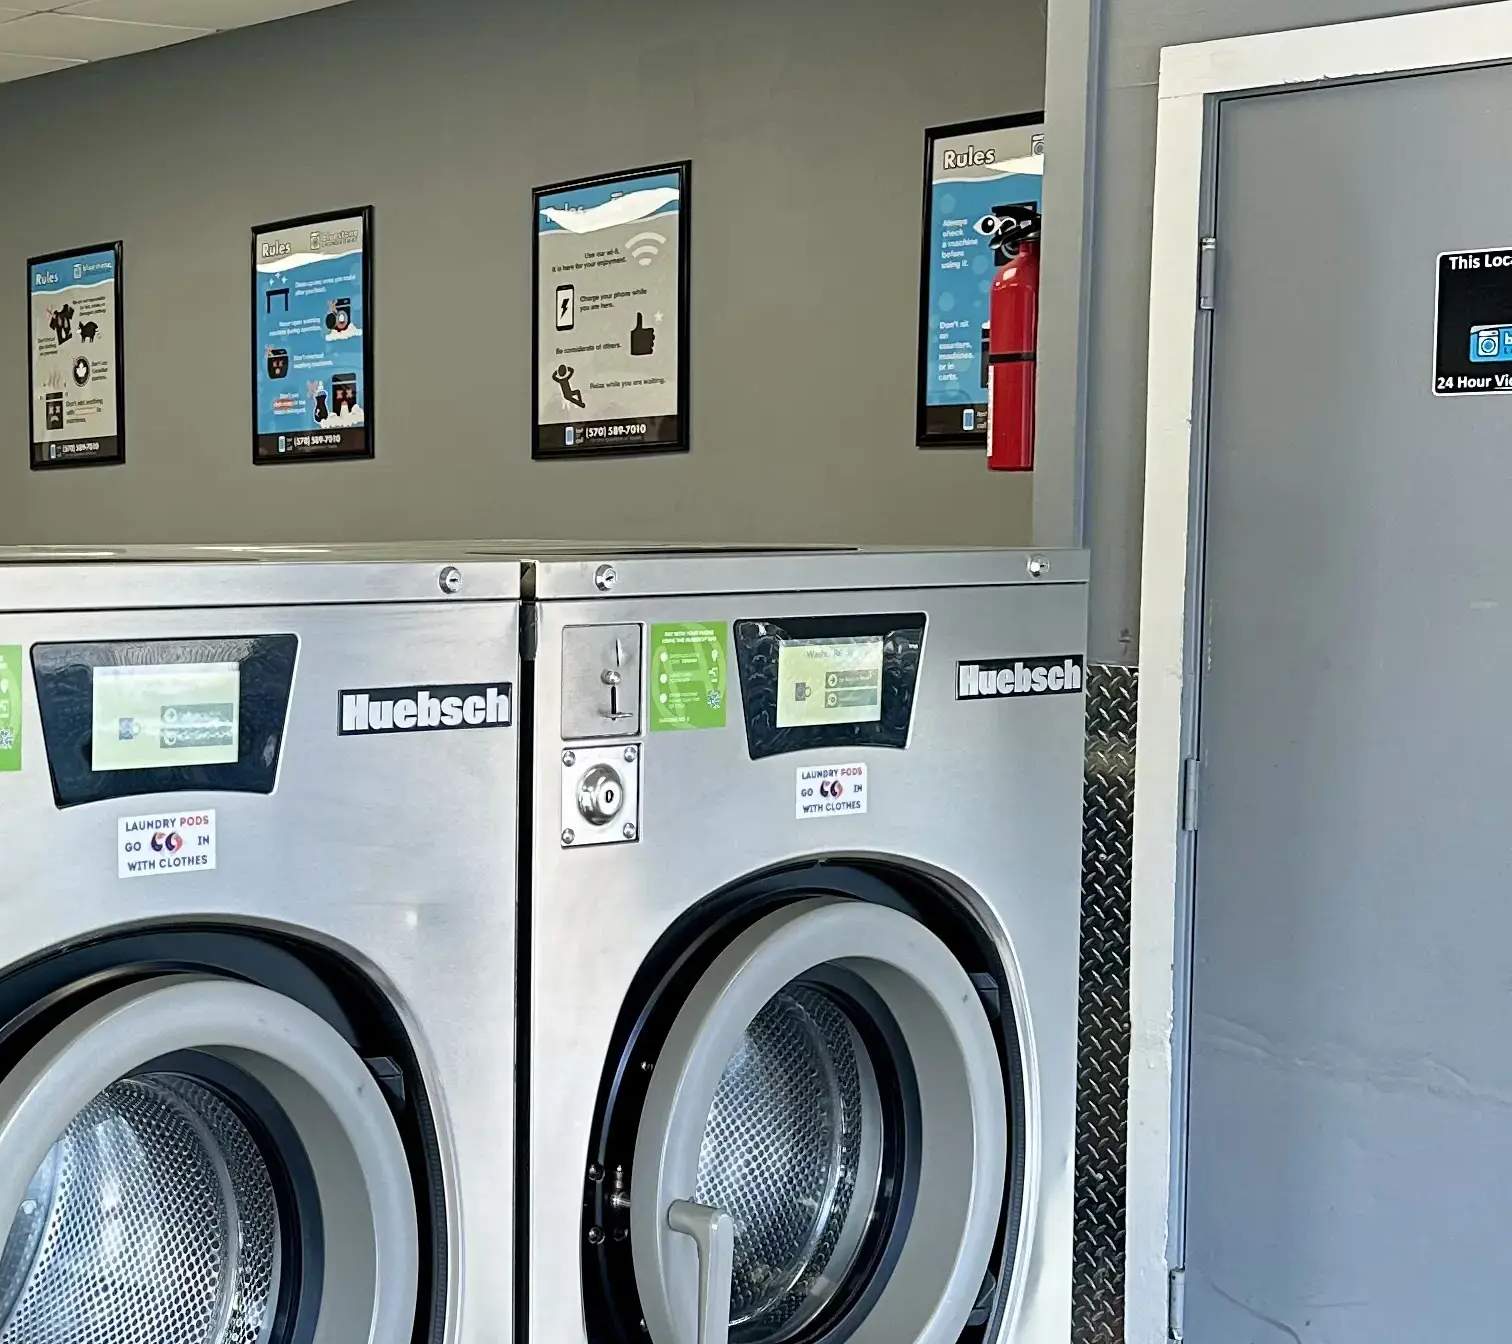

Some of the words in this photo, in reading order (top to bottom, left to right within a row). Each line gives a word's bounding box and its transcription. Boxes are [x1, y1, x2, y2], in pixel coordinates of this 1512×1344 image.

[943, 145, 995, 170] Rules
[262, 240, 291, 258] Rules
[1449, 255, 1480, 270] This
[36, 271, 59, 285] Rules
[1437, 377, 1454, 389] 24
[1457, 376, 1492, 388] Hour
[959, 659, 1081, 696] Huebsch
[342, 688, 509, 731] Huebsch
[802, 769, 839, 779] LAUNDRY
[840, 767, 862, 776] PODS
[801, 788, 813, 797] GO
[853, 784, 862, 793] IN
[802, 804, 823, 813] WITH
[825, 800, 861, 811] CLOTHES
[125, 818, 176, 832] LAUNDRY
[179, 815, 209, 827] PODS
[125, 841, 141, 852] GO
[197, 835, 209, 845] IN
[127, 859, 156, 871] WITH
[159, 855, 208, 868] CLOTHES
